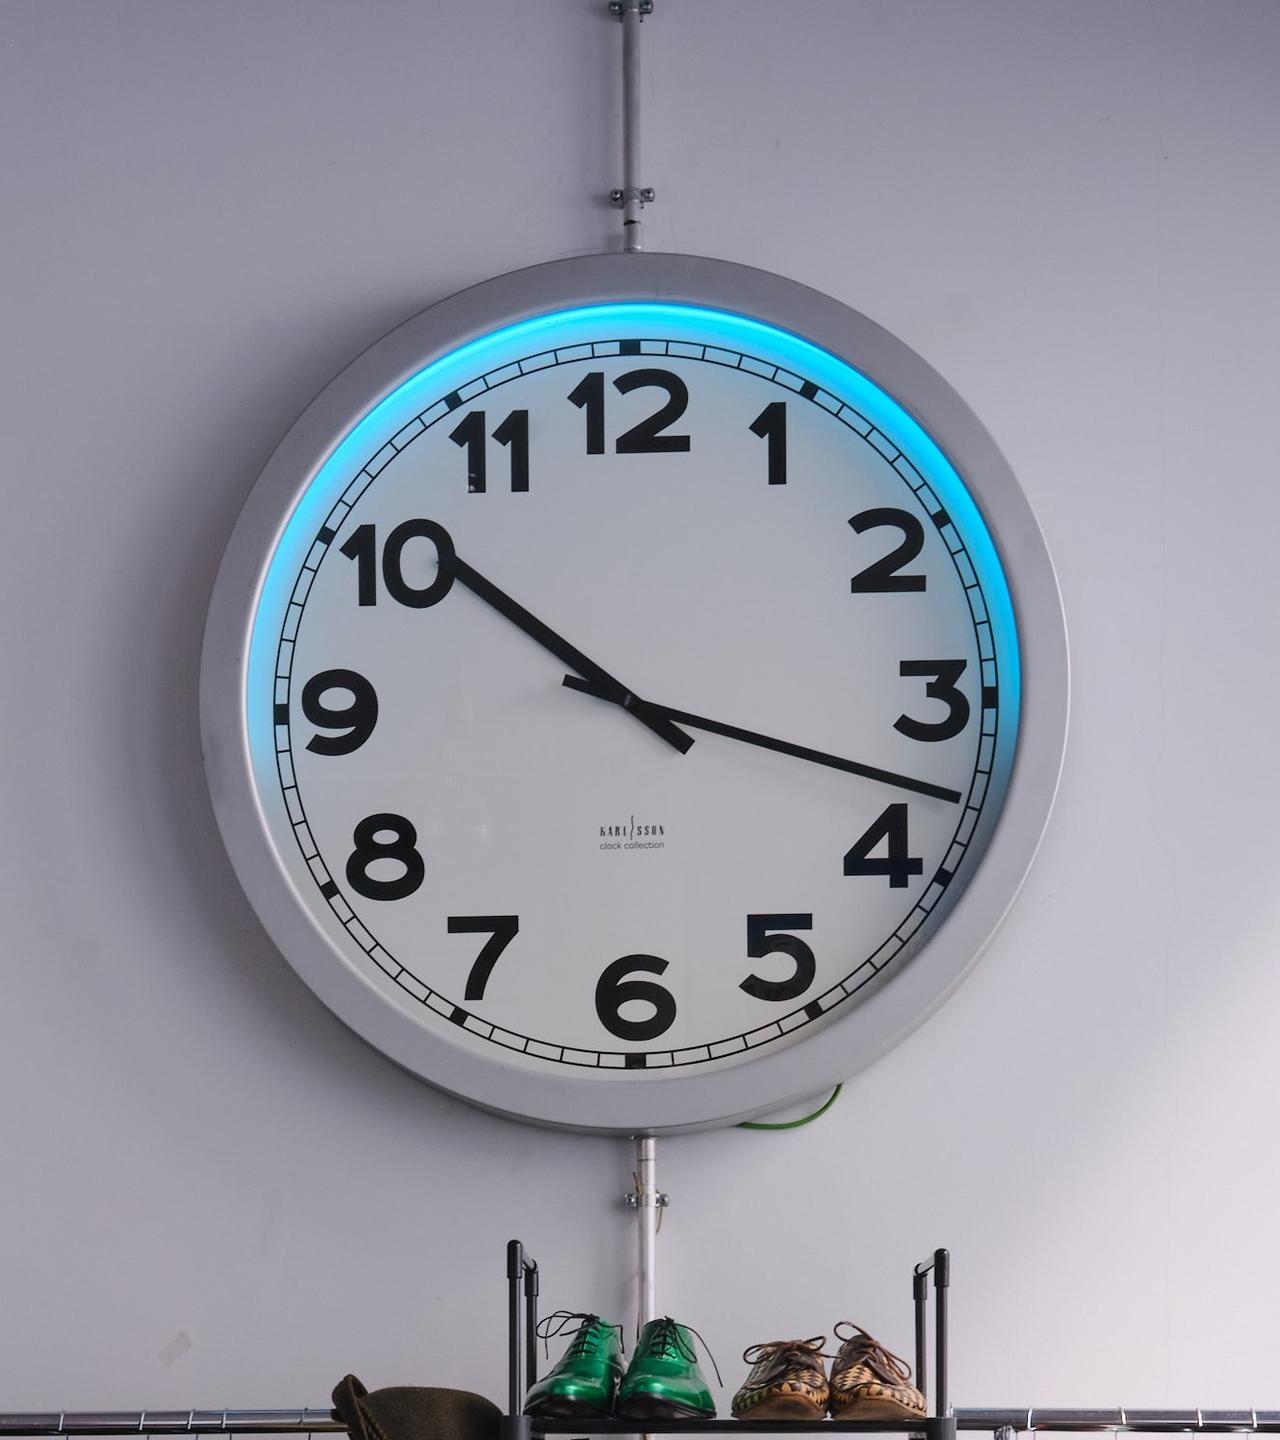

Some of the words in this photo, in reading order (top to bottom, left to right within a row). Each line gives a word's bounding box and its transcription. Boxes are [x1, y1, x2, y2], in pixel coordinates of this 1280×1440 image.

[449, 410, 529, 493] 11
[567, 369, 691, 454] 12
[749, 402, 787, 485] 1
[339, 519, 457, 609] 10
[848, 508, 927, 593] 2
[301, 669, 379, 756] 9
[893, 659, 971, 742] 3
[346, 813, 425, 901] 8
[599, 841, 622, 850] clock
[623, 840, 665, 850] collection
[843, 803, 923, 888] 4
[447, 916, 519, 1000] 7
[595, 954, 677, 1041] 6
[738, 913, 816, 1002] 5
